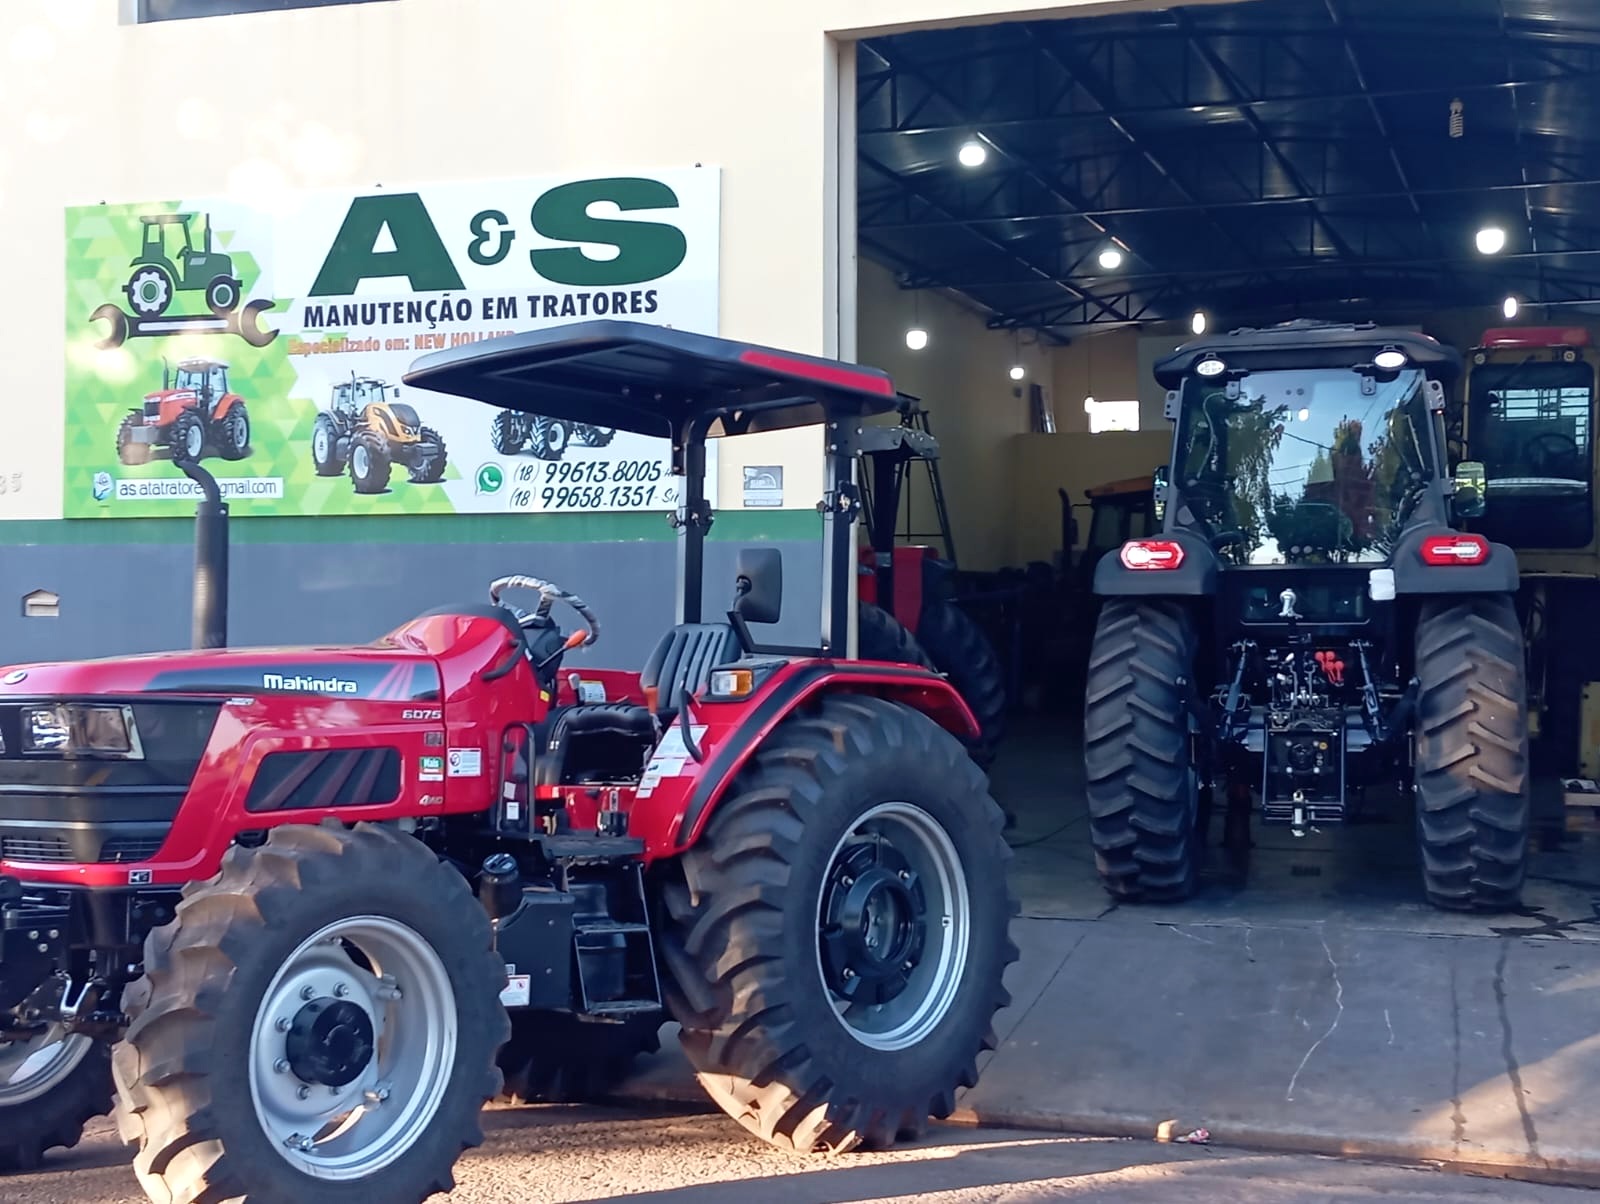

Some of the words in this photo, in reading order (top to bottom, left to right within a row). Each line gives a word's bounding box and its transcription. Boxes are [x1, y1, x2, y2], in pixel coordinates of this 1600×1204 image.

[303, 293, 473, 330] MANUTENÇÃO
[482, 297, 518, 320] EM
[527, 290, 658, 318] TRATORES
[414, 332, 447, 350] NEW
[513, 461, 541, 484] (18)
[509, 487, 537, 509] (18)
[263, 673, 358, 693] Mahindra
[402, 709, 442, 720] 6075
